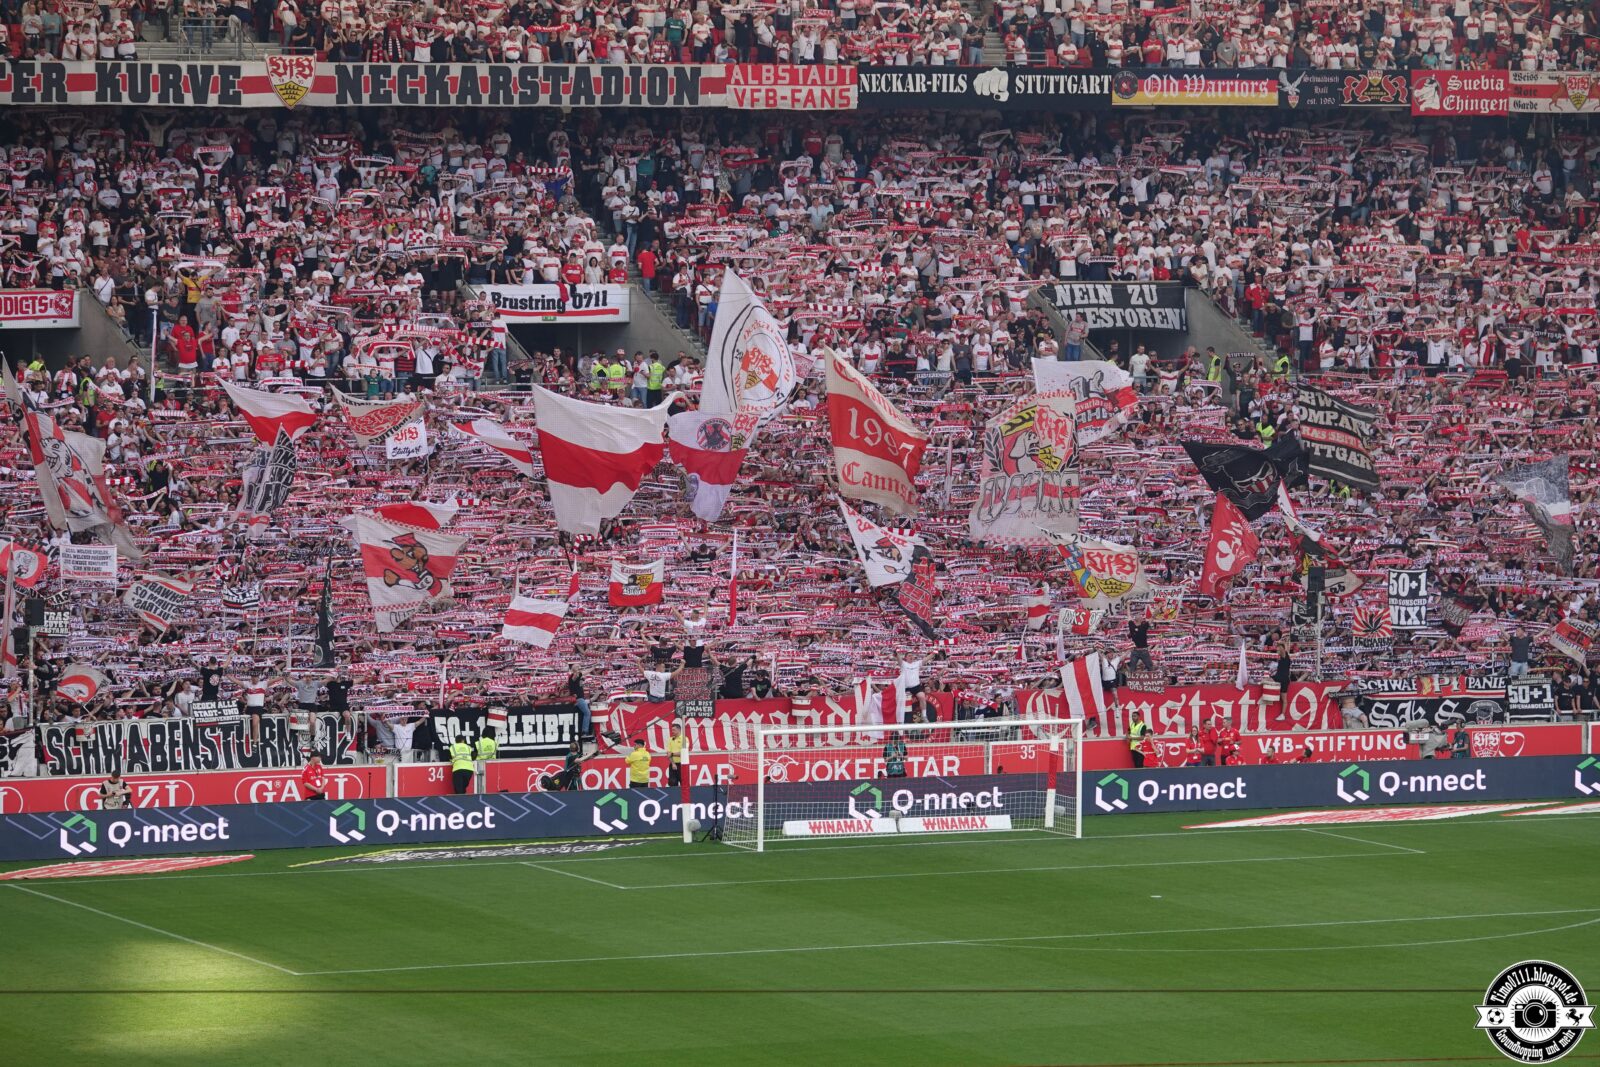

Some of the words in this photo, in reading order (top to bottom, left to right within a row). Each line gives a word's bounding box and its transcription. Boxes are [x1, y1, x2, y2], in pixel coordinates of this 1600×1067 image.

[0, 63, 67, 104] ER
[95, 63, 242, 105] KURVE
[335, 63, 702, 106] NECKARSTADION
[731, 65, 856, 85] ALBSTADT
[859, 73, 968, 94] NECKAR-FILS
[1015, 73, 1112, 96] STUTTGART
[1144, 73, 1179, 98] Old
[1183, 73, 1269, 98] Warriors
[1447, 75, 1505, 91] Suebia
[733, 87, 851, 109] VFB-FANS
[1513, 100, 1538, 110] Garde
[0, 295, 48, 316] DICTS
[491, 291, 566, 313] Brustring
[571, 290, 608, 309] 0711
[1054, 283, 1114, 306] NEIN
[1127, 284, 1158, 306] ZU
[847, 407, 915, 469] 1997
[391, 444, 422, 457] Stuttgart
[1086, 551, 1136, 577] VfB
[1389, 571, 1428, 597] 50+1
[44, 611, 70, 621] TRAS
[1463, 677, 1507, 691] PANIE
[1507, 684, 1554, 703] 50+1
[217, 700, 237, 709] ALLE
[223, 708, 240, 716] UND
[385, 710, 425, 719] COMMANDO
[1290, 684, 1343, 731] 97
[46, 714, 301, 777] SCHWABENSTURM
[1020, 745, 1036, 760] 35
[1257, 734, 1407, 754] VfB-STIFTUNG
[428, 767, 444, 782] 34
[798, 756, 961, 782] JOKERTAR
[250, 773, 348, 804] GAI
[1138, 776, 1247, 806] Q-nnect
[1379, 768, 1487, 797] Q-nnect
[79, 779, 181, 811] GZI
[893, 786, 1004, 816] Q-nnect
[376, 805, 496, 836] Q-nnect
[809, 819, 874, 834] WINAMAX
[923, 816, 988, 831] WINAMAX
[108, 817, 230, 848] Q-nnect
